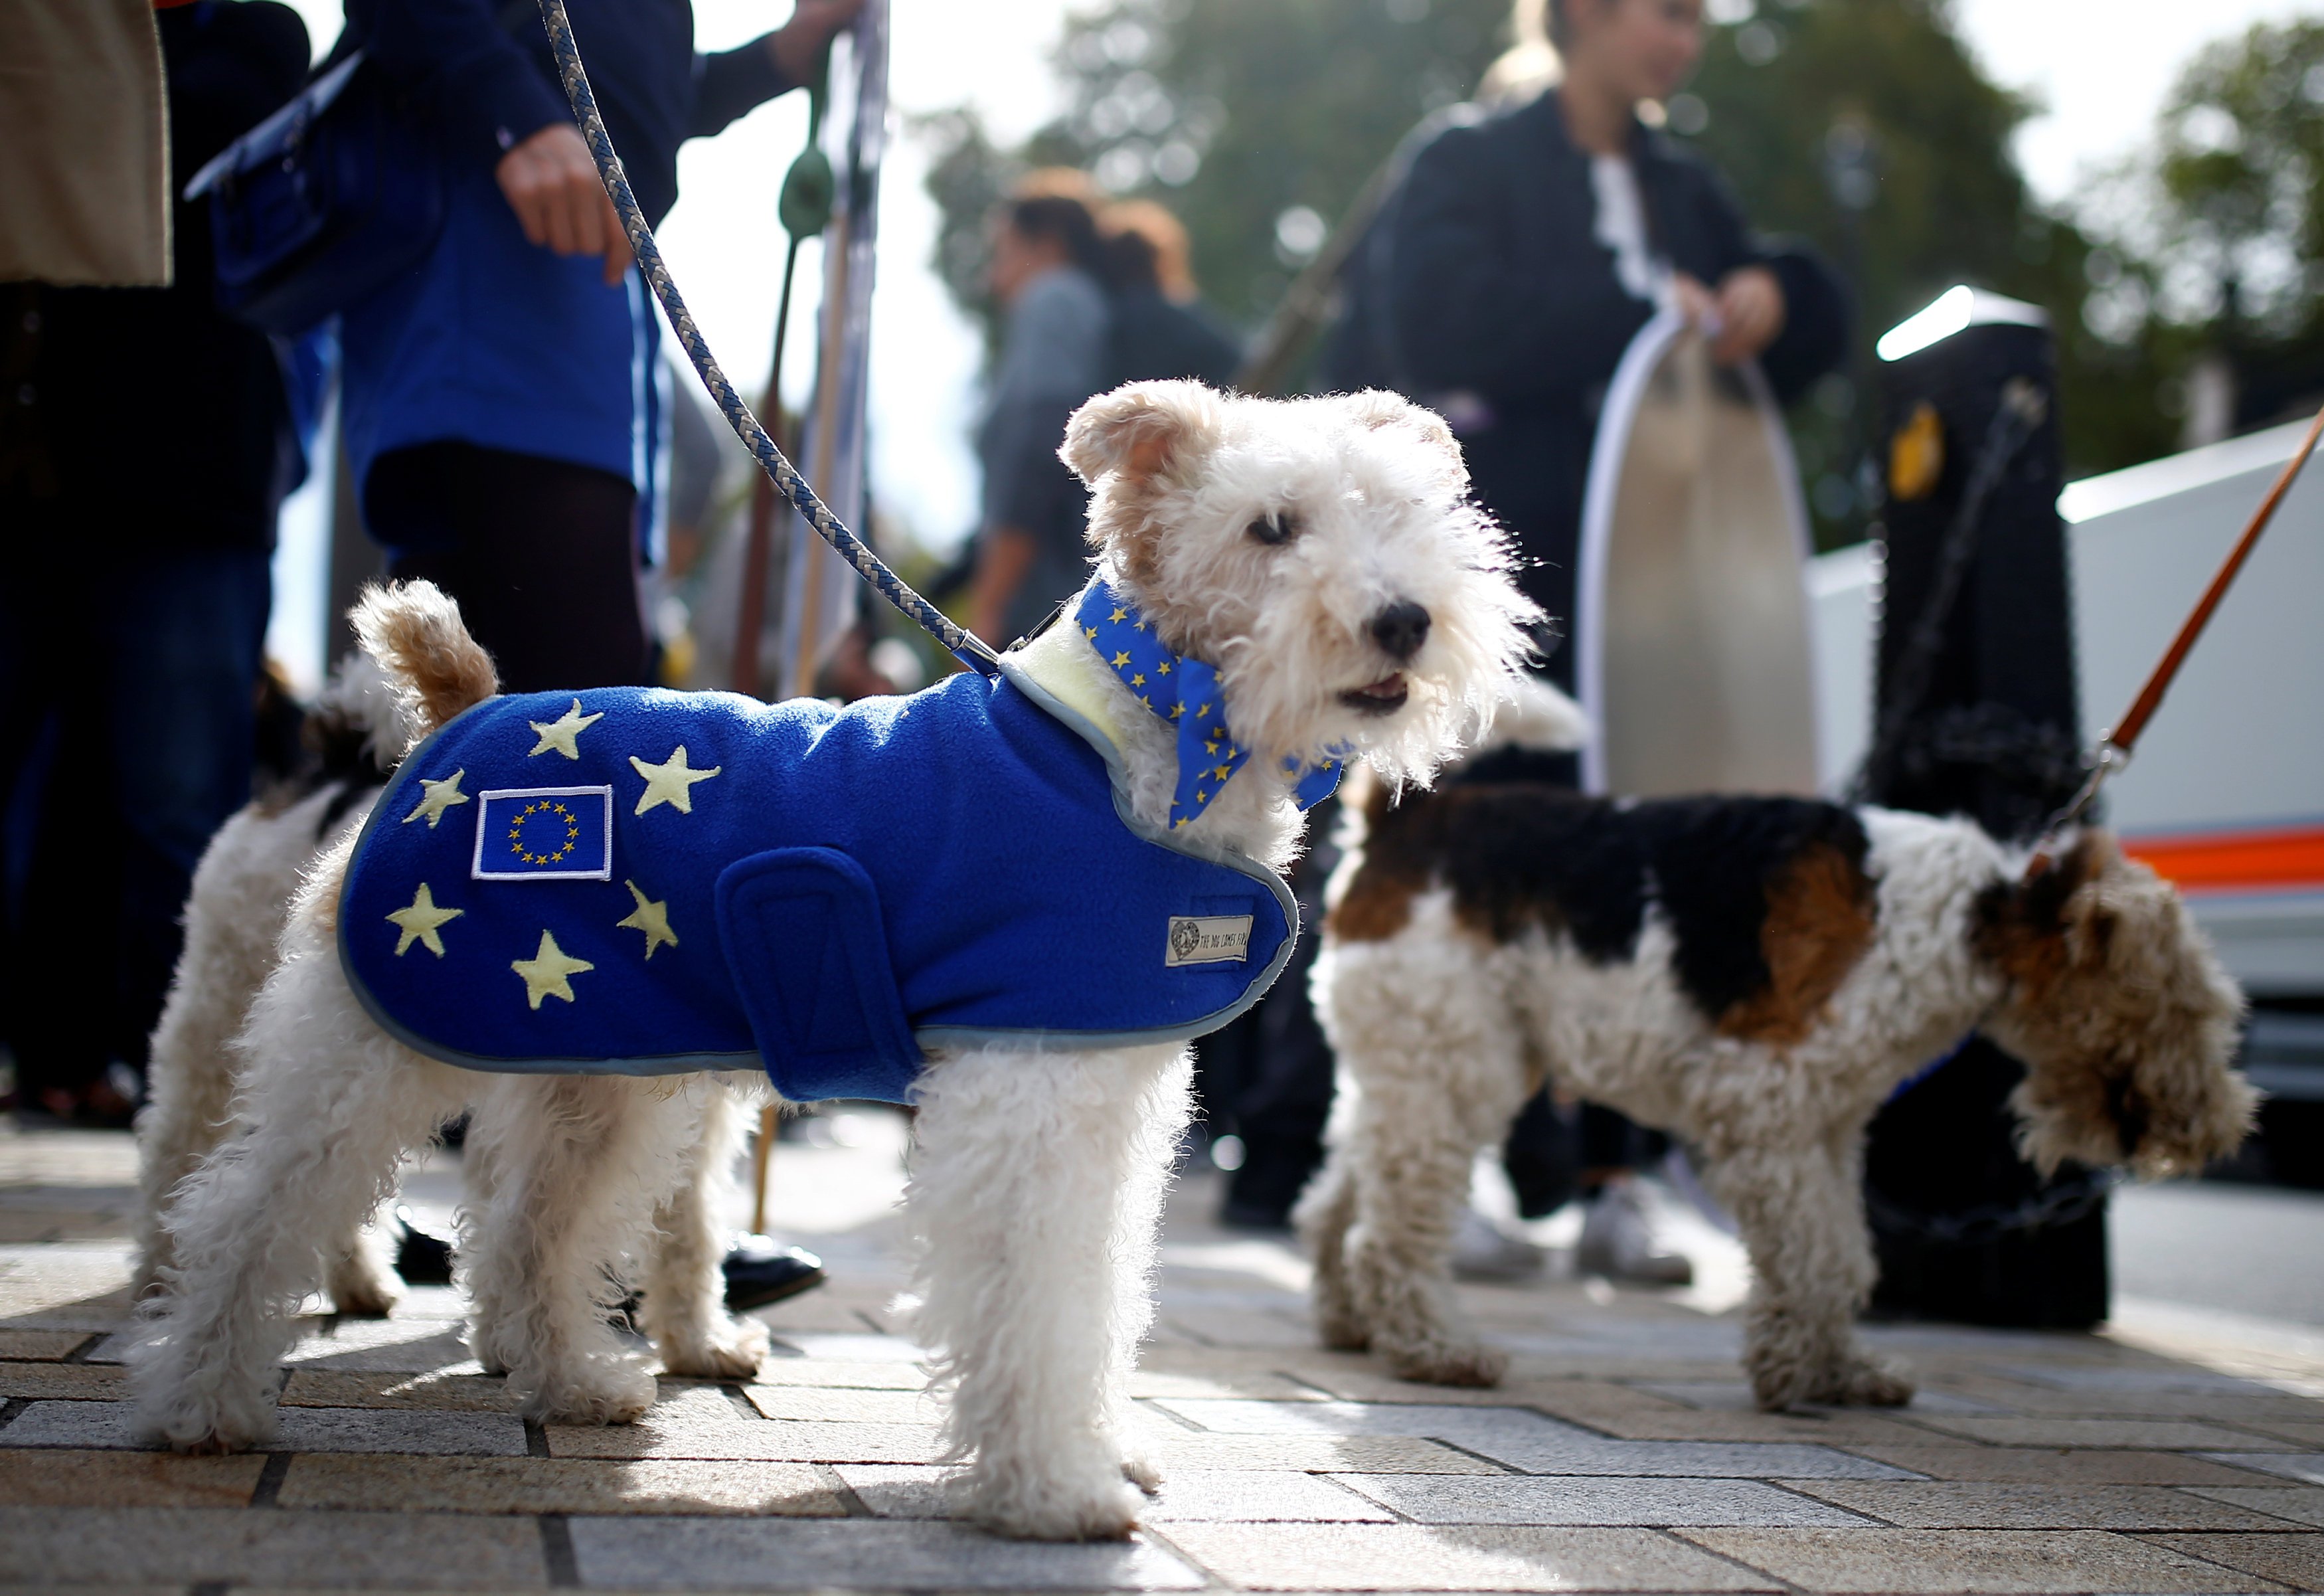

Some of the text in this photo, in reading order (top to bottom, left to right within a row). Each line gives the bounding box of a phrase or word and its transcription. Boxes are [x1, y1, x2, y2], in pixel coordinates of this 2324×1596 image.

[1200, 934, 1210, 949] THE
[1210, 934, 1220, 948] DOG
[1220, 933, 1236, 948] COMES
